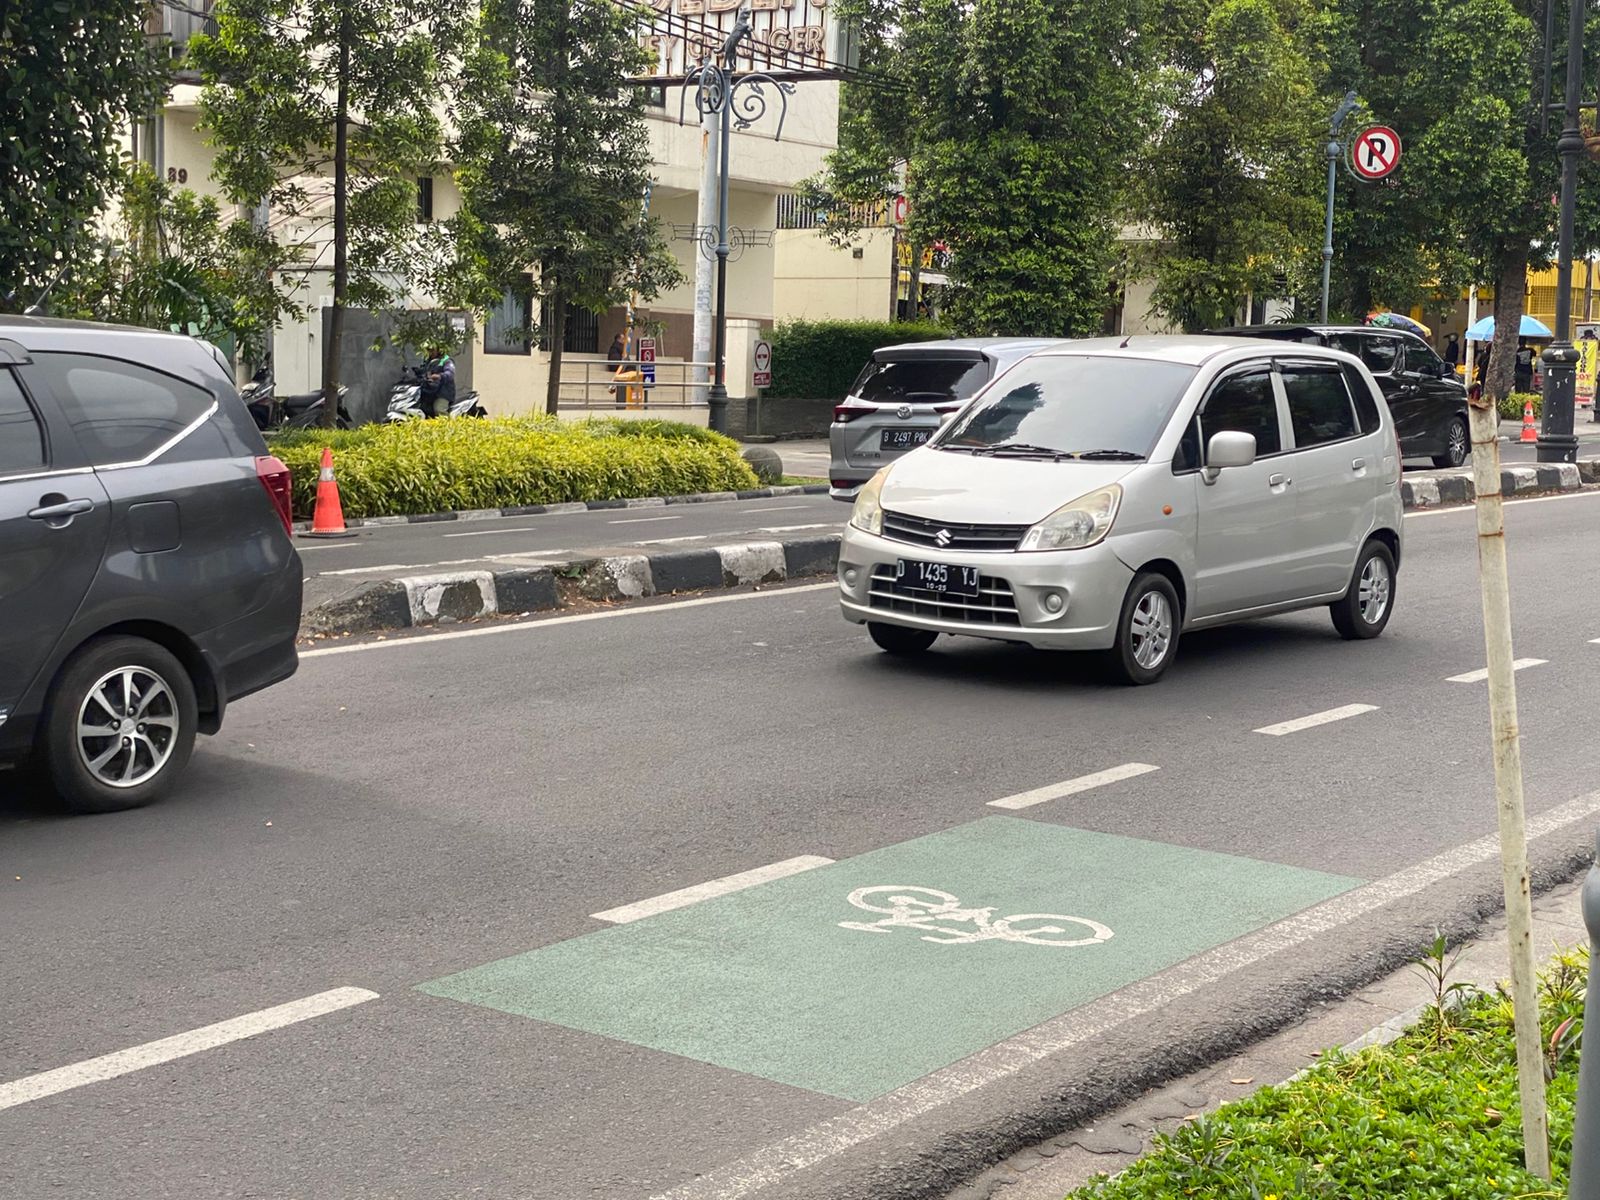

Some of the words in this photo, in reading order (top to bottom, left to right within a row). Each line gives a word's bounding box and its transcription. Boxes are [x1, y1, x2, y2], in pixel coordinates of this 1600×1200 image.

[884, 431, 890, 442] B
[893, 431, 912, 443] 2497
[897, 560, 905, 577] D
[919, 562, 948, 583] 1435
[961, 567, 979, 586] YJ
[926, 582, 947, 592] 10-25
